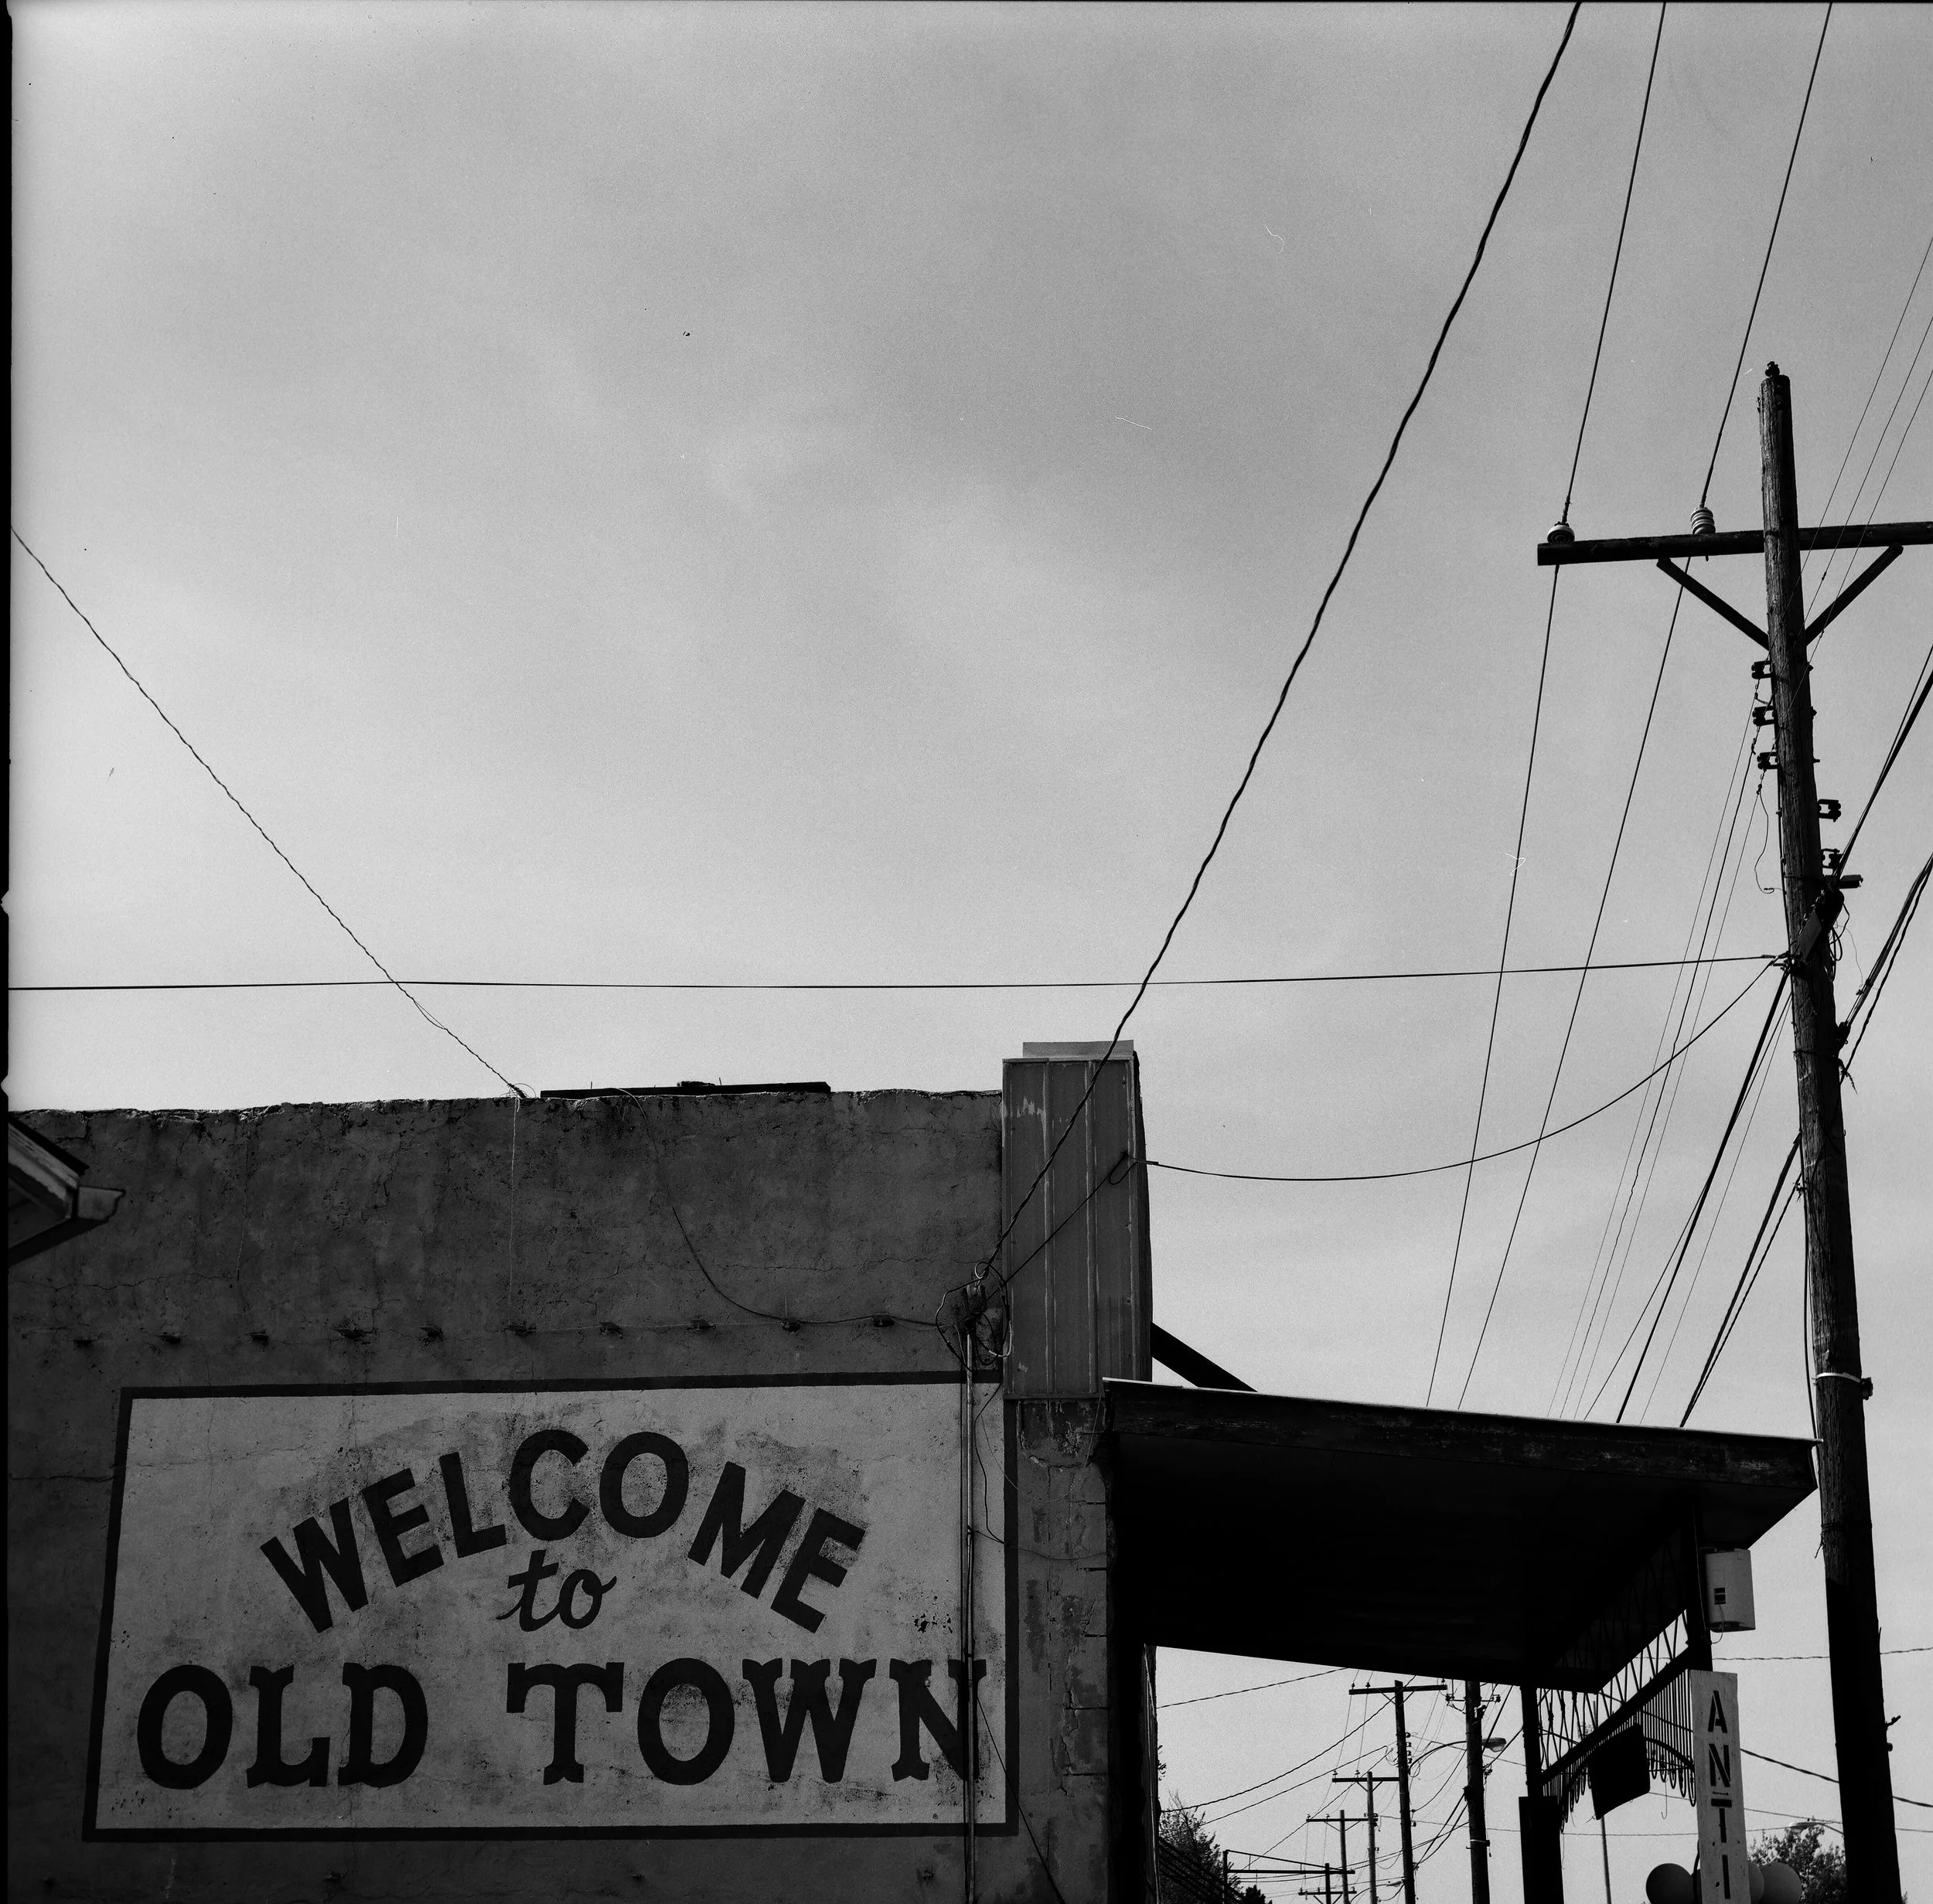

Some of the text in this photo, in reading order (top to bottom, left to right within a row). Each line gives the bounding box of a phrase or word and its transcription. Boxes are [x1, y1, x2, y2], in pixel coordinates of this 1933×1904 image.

[259, 1429, 867, 1633] WELCOME
[496, 1549, 616, 1632] to
[137, 1658, 987, 1790] OLD TOWN
